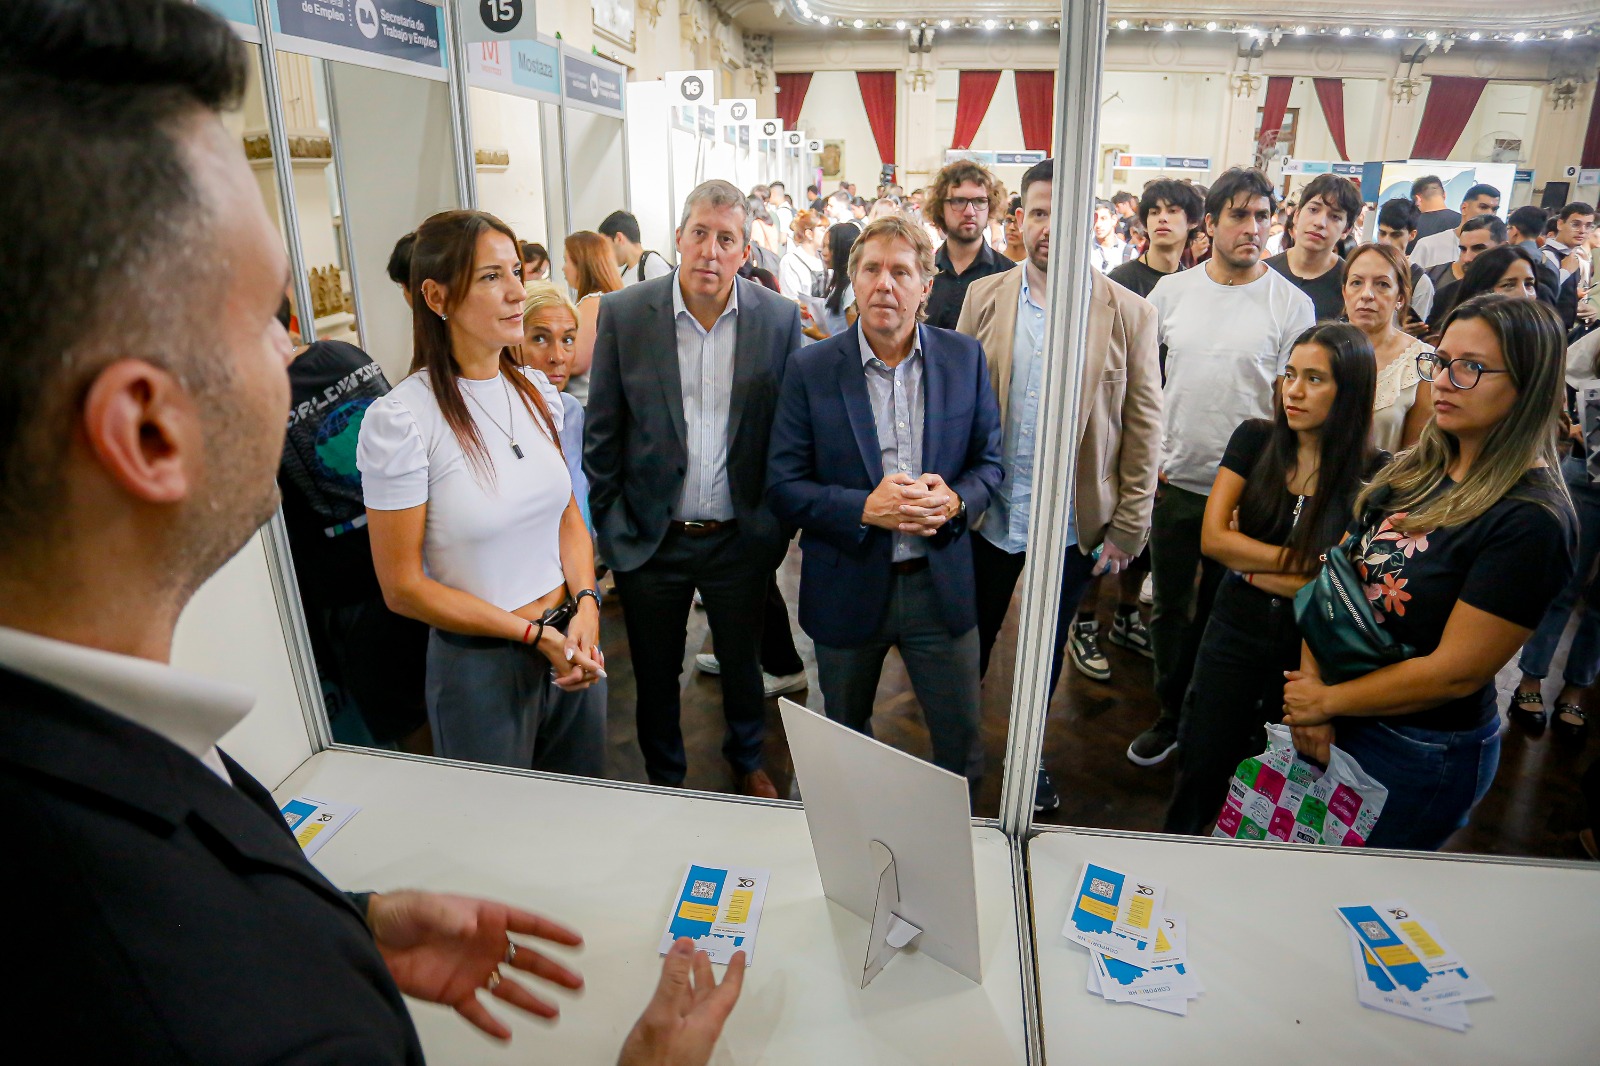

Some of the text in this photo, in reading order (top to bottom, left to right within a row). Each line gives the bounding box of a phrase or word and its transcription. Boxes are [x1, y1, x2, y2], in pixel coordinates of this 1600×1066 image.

[301, 2, 345, 22] de Empleo
[487, 0, 515, 21] 15
[381, 23, 408, 43] Trabajo
[413, 32, 438, 48] Empleo
[415, 19, 425, 32] de
[518, 51, 553, 78] Mostaza
[684, 81, 701, 96] 16
[732, 106, 746, 117] 17
